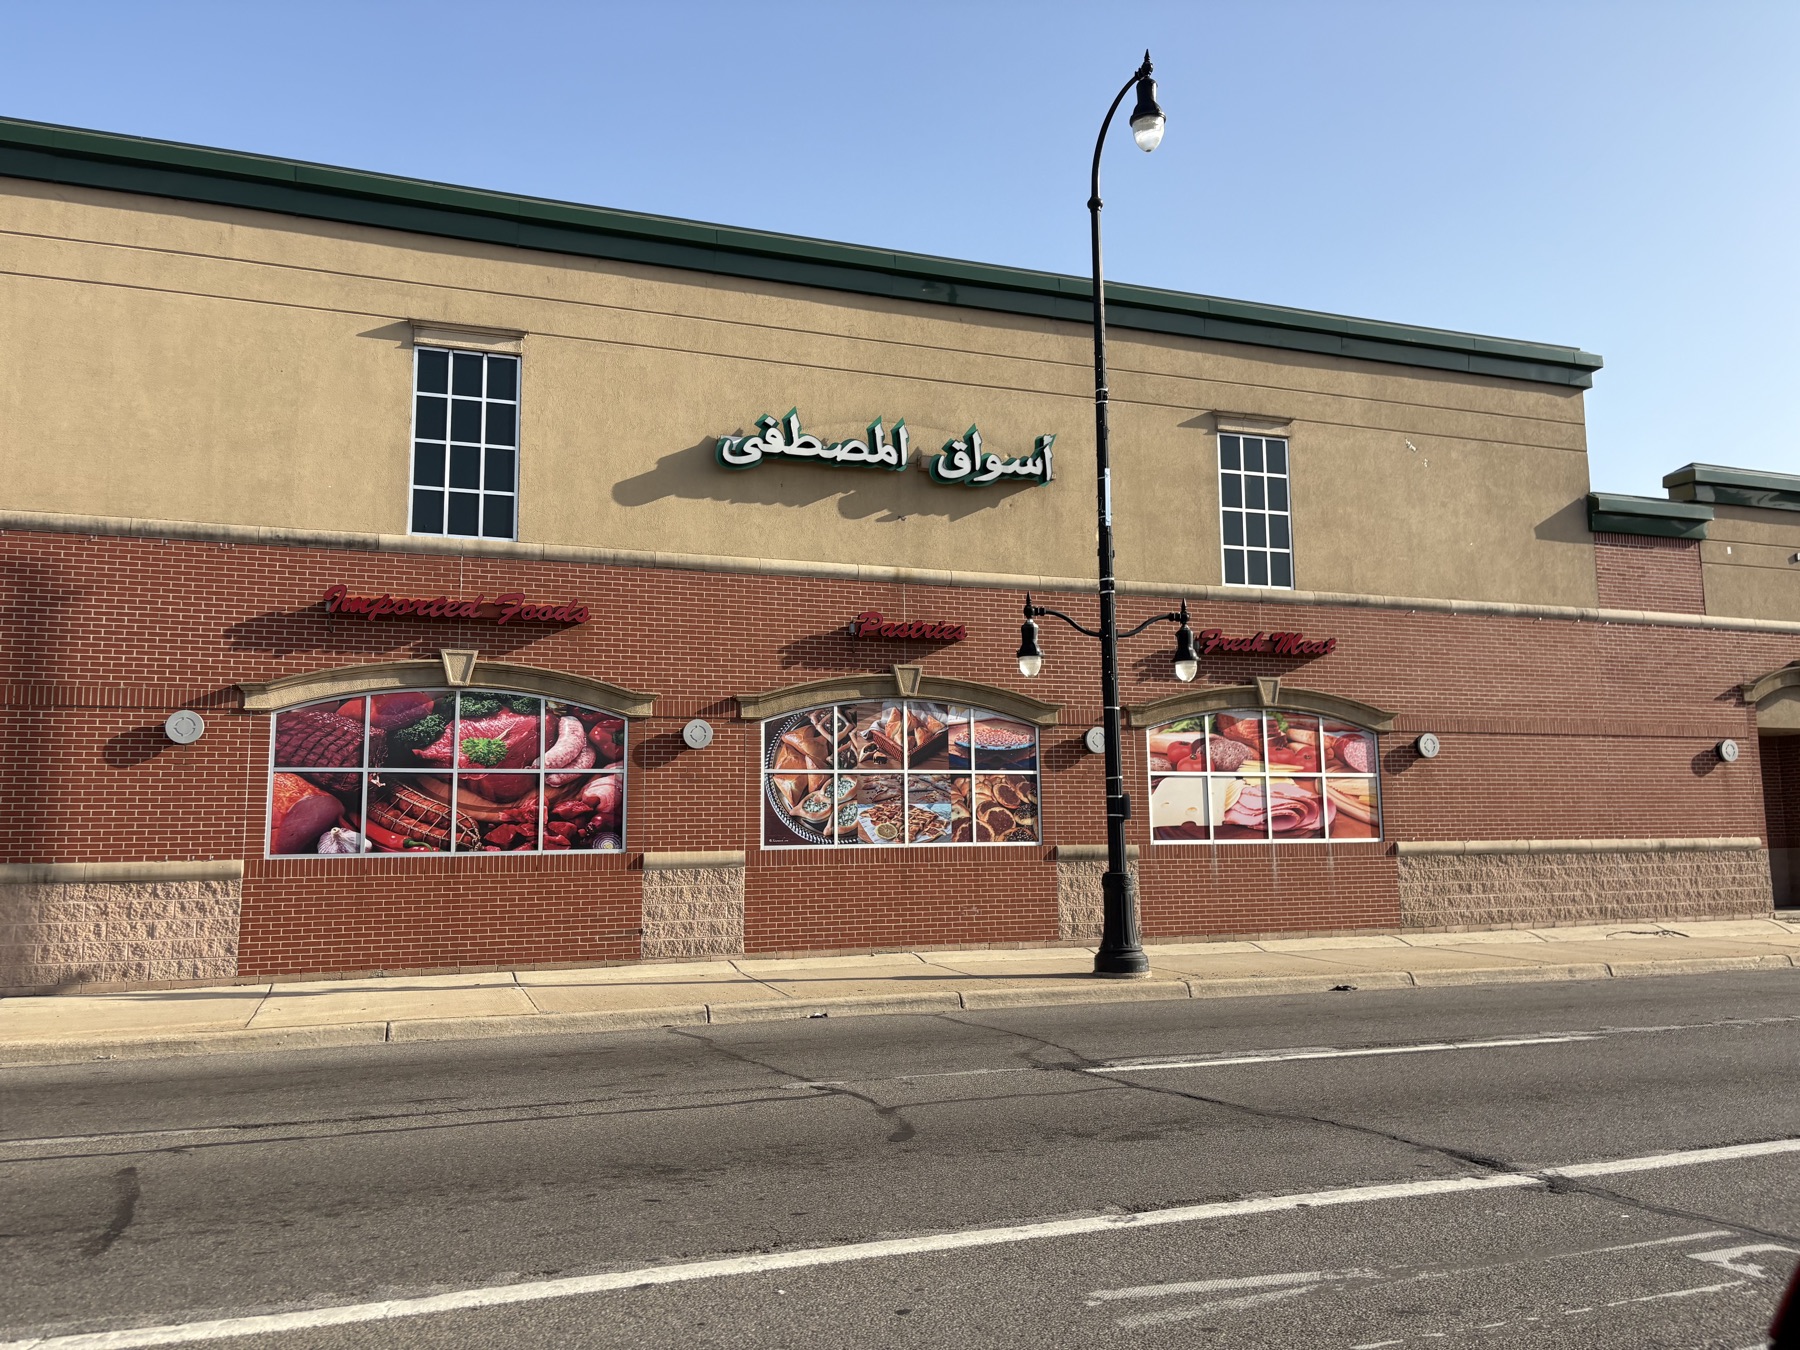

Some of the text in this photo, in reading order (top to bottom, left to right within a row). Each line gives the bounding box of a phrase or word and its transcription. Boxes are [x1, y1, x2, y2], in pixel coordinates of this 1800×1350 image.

[716, 407, 909, 471] المصطفى
[323, 584, 592, 624] Imported Foods
[858, 611, 967, 640] Pastries
[1201, 629, 1337, 655] Fresh Meat
